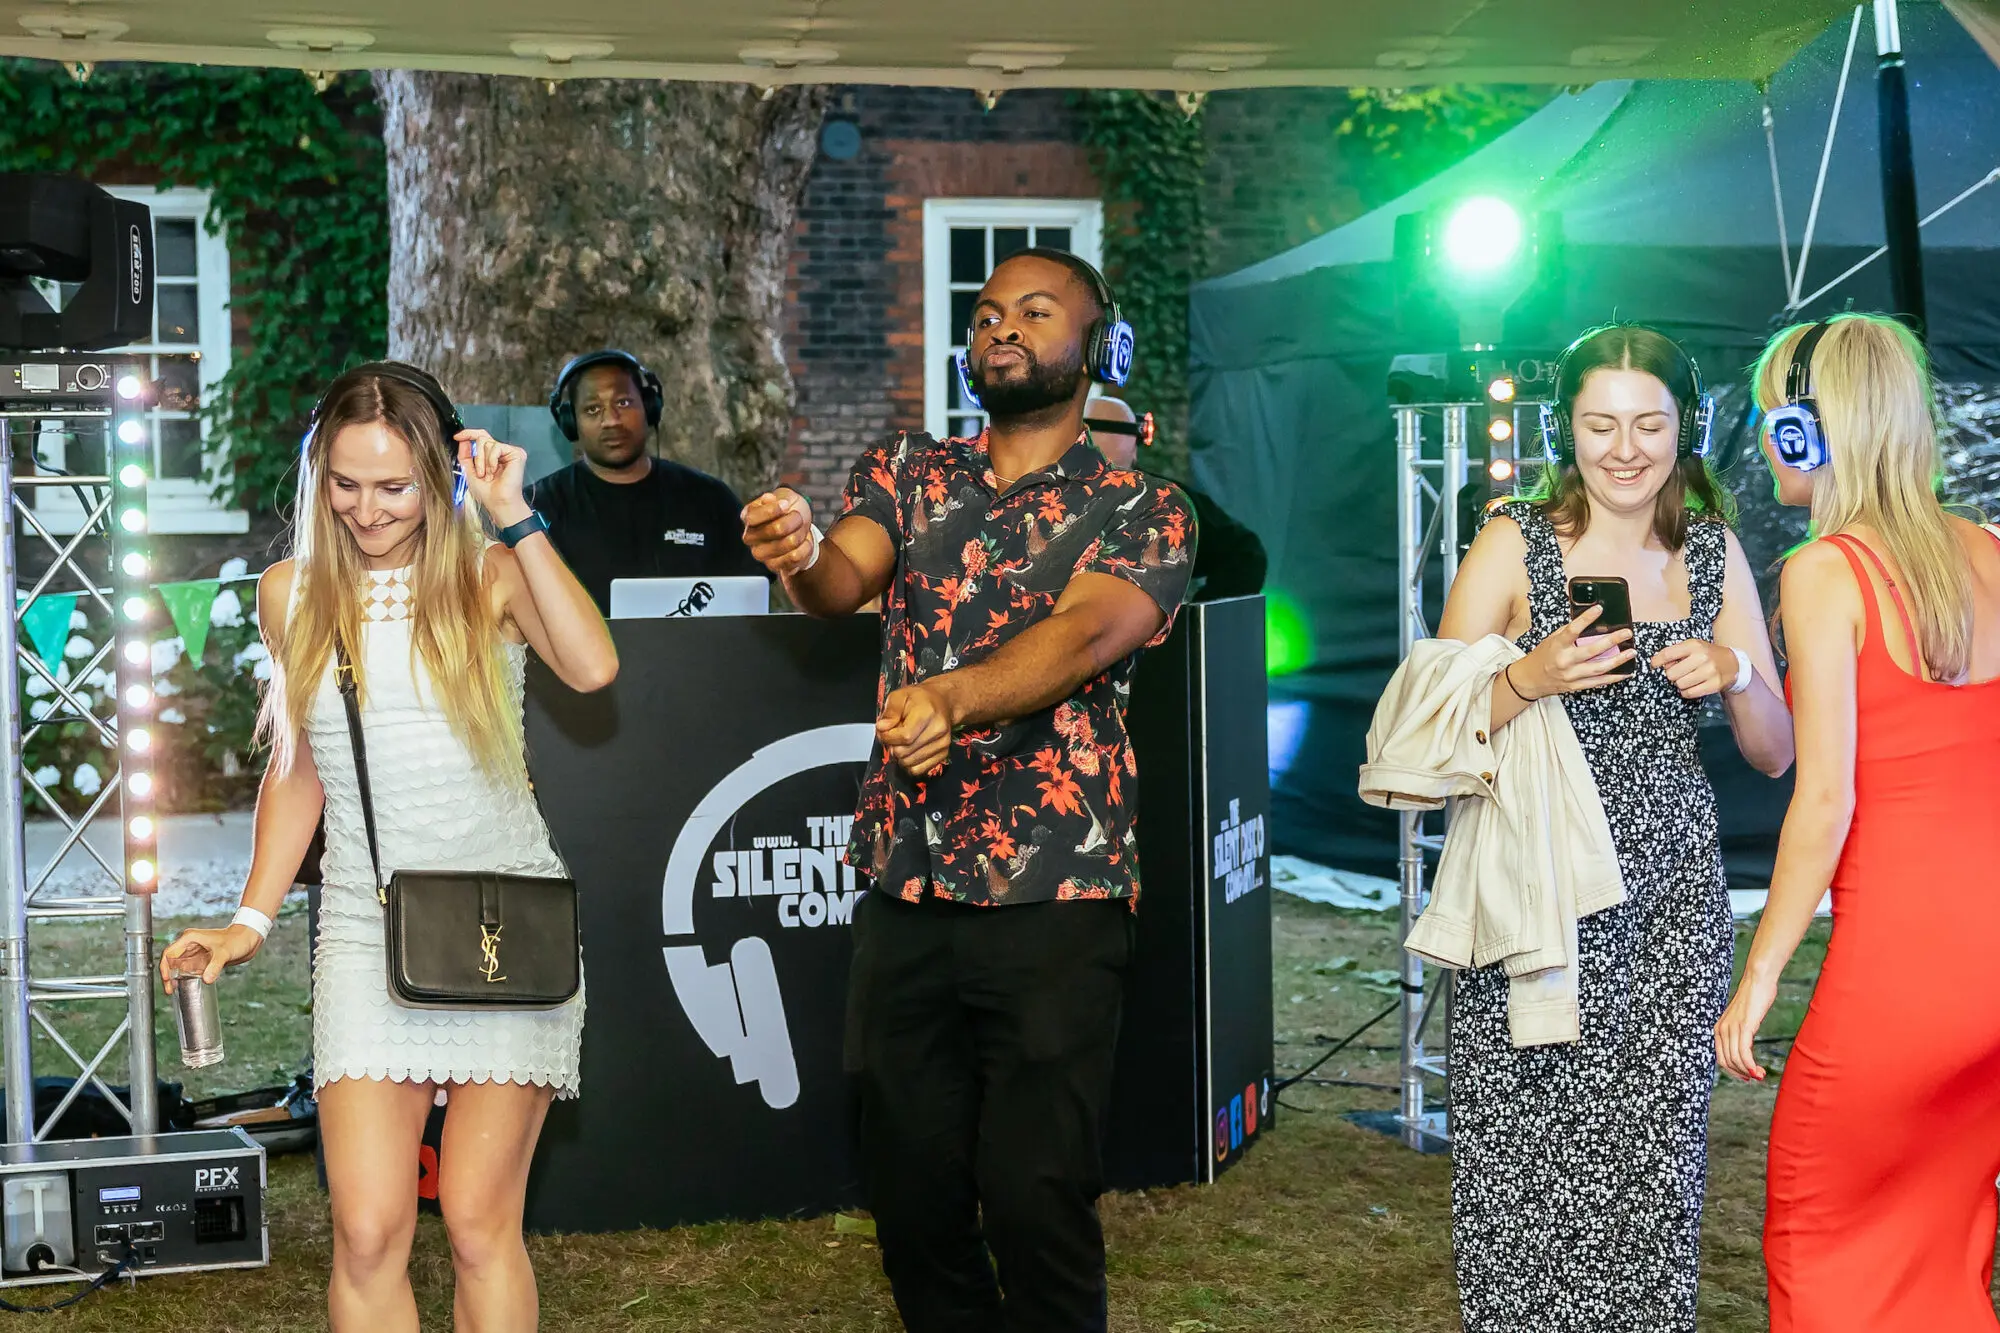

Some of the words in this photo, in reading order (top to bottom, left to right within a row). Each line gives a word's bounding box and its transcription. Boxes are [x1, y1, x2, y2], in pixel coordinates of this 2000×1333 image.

[132, 234, 140, 270] BEAM
[753, 835, 798, 849] www.
[712, 846, 856, 898] SILENT
[479, 925, 507, 982] YSL
[195, 1166, 239, 1187] PFX
